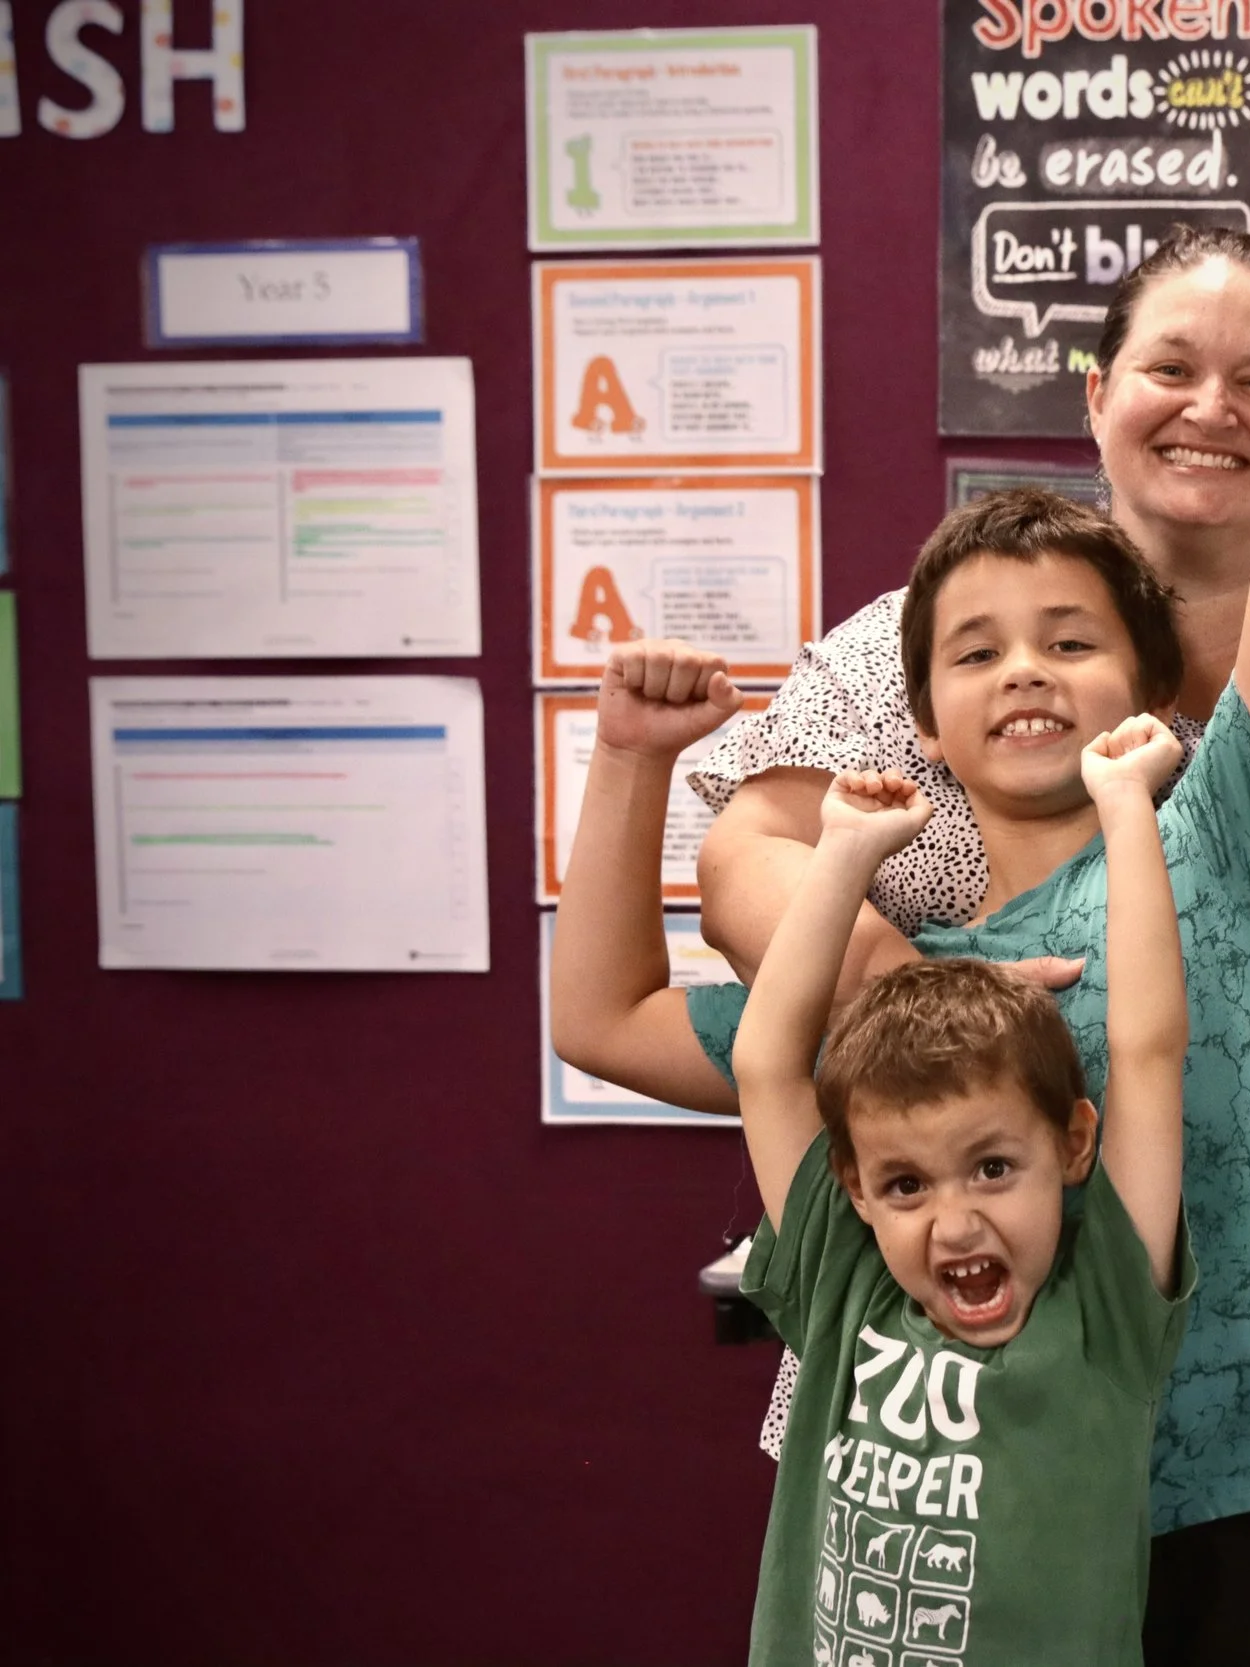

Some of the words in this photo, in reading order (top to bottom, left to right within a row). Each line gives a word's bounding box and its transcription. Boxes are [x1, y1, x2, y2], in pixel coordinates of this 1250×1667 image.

[971, 53, 1154, 120] words
[1166, 67, 1246, 109] can't
[971, 133, 1027, 188] be
[1044, 128, 1238, 190] erased.
[992, 227, 1079, 283] Don't
[236, 272, 306, 303] Year
[973, 336, 1060, 374] what
